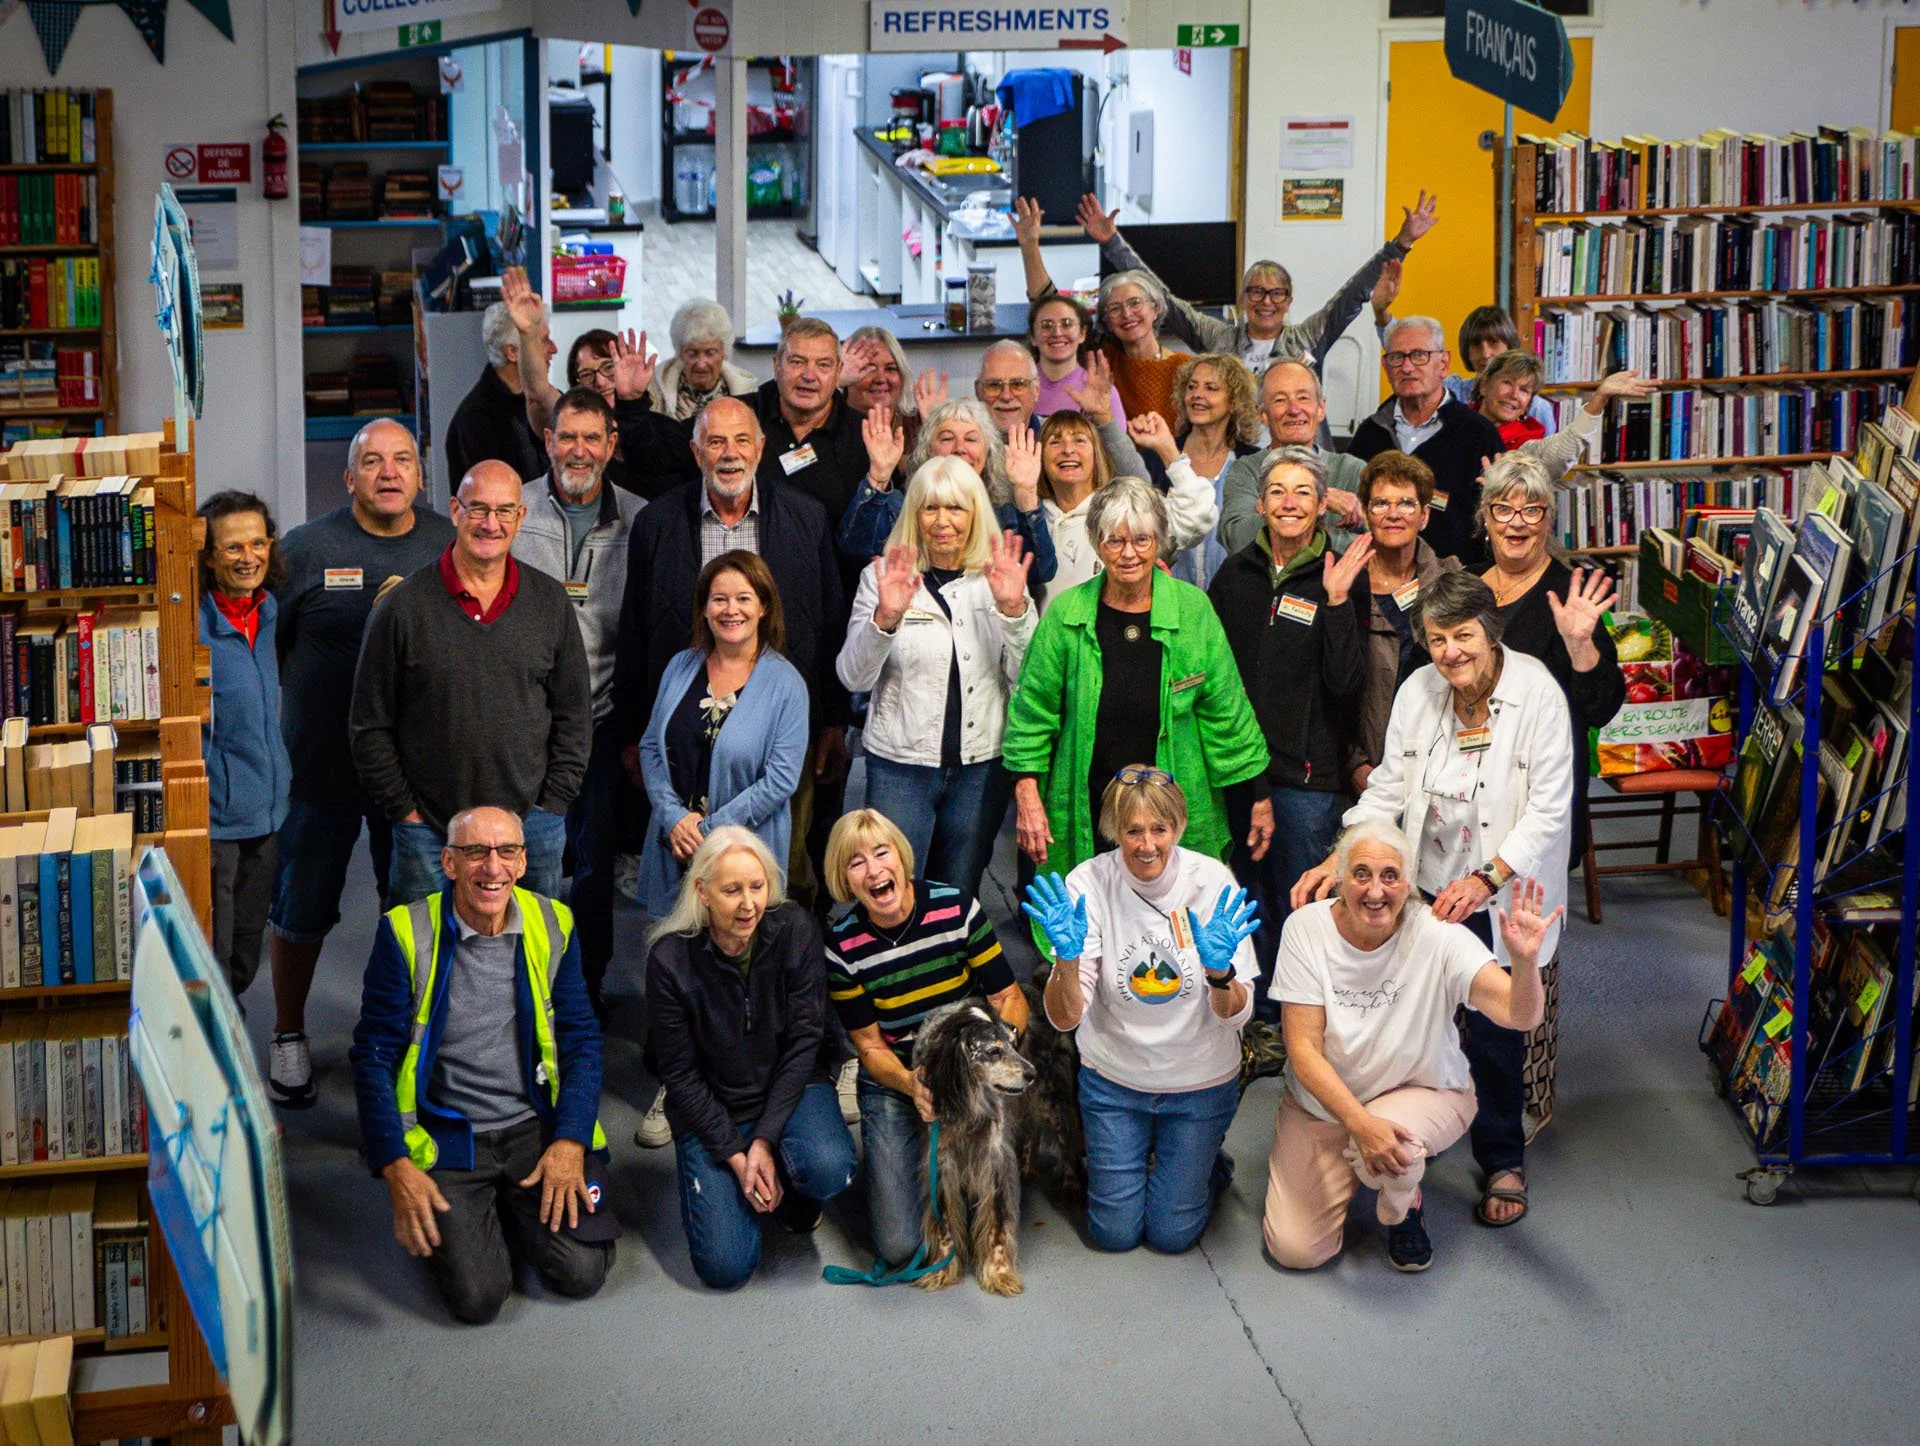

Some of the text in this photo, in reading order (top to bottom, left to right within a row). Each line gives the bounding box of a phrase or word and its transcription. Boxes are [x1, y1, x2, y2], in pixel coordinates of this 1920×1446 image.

[883, 8, 1109, 33] REFRESHMENTS
[1465, 9, 1537, 82] FRANÇAIS
[208, 170, 240, 178] FUMER
[218, 159, 229, 168] DE
[133, 507, 143, 550] MARTIN
[1622, 707, 1688, 722] EN ROUTE
[1604, 725, 1643, 737] VERS
[1753, 699, 1781, 760] TERRE
[1117, 942, 1137, 1002] PHOENIX
